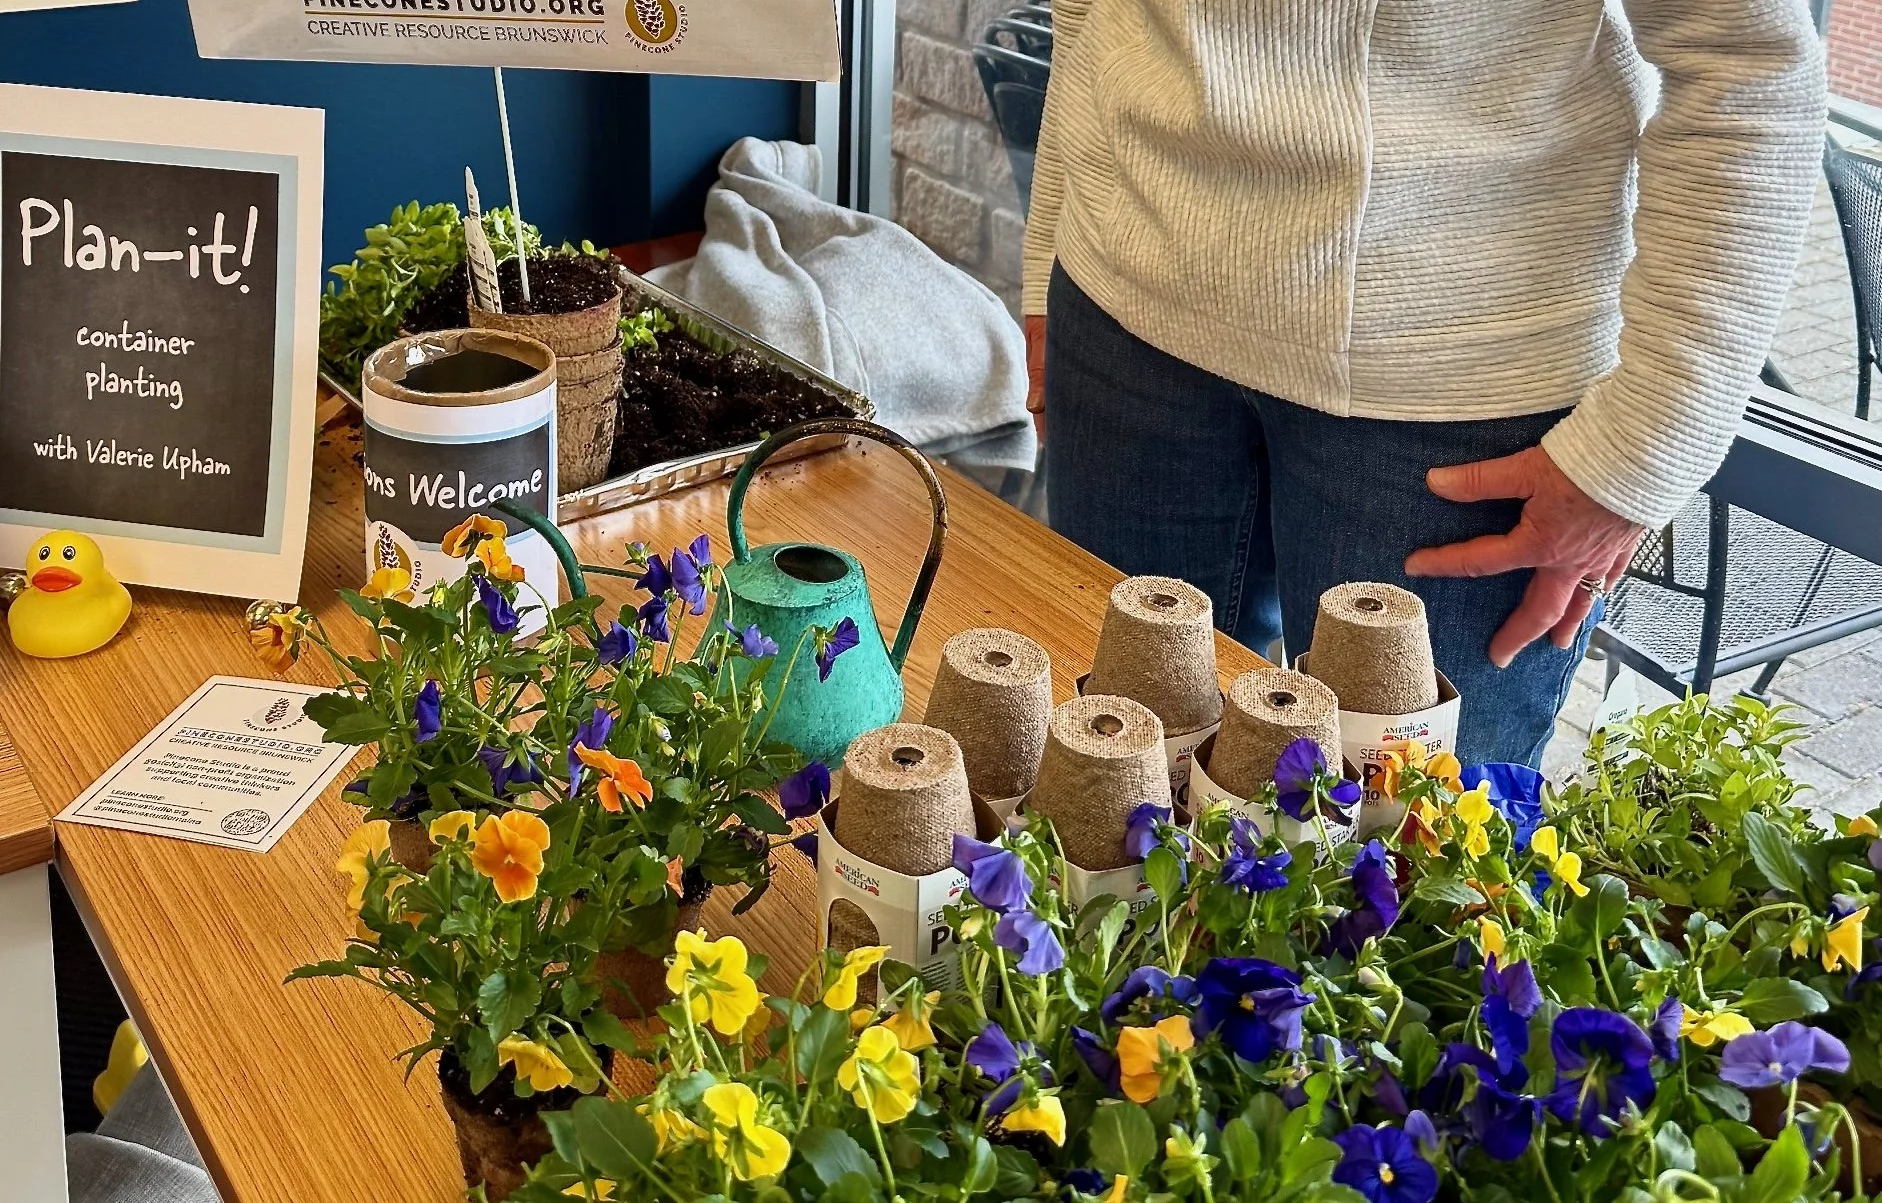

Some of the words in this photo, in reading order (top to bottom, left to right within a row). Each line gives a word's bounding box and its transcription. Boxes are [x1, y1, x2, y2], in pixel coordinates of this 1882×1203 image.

[307, 19, 391, 38] CREATIVE
[394, 23, 490, 41] RESOURCE
[494, 26, 609, 45] BRUNSWICK
[624, 31, 675, 54] PINECONE
[675, 4, 689, 45] STUDIO
[19, 197, 259, 295] Plan-it!
[76, 319, 195, 357] container
[85, 361, 183, 409] planting
[33, 434, 78, 461] with
[86, 439, 155, 470] Valerie
[162, 446, 231, 480] Upham
[408, 468, 543, 510] Welcome
[409, 560, 422, 592] TUDIO
[168, 737, 211, 749] CREATIVE
[210, 742, 258, 756] RESOURCE
[258, 750, 315, 764] BRUNSWICK
[176, 728, 324, 756] PINECONESTUDIO.ORG
[1364, 790, 1380, 801] 10
